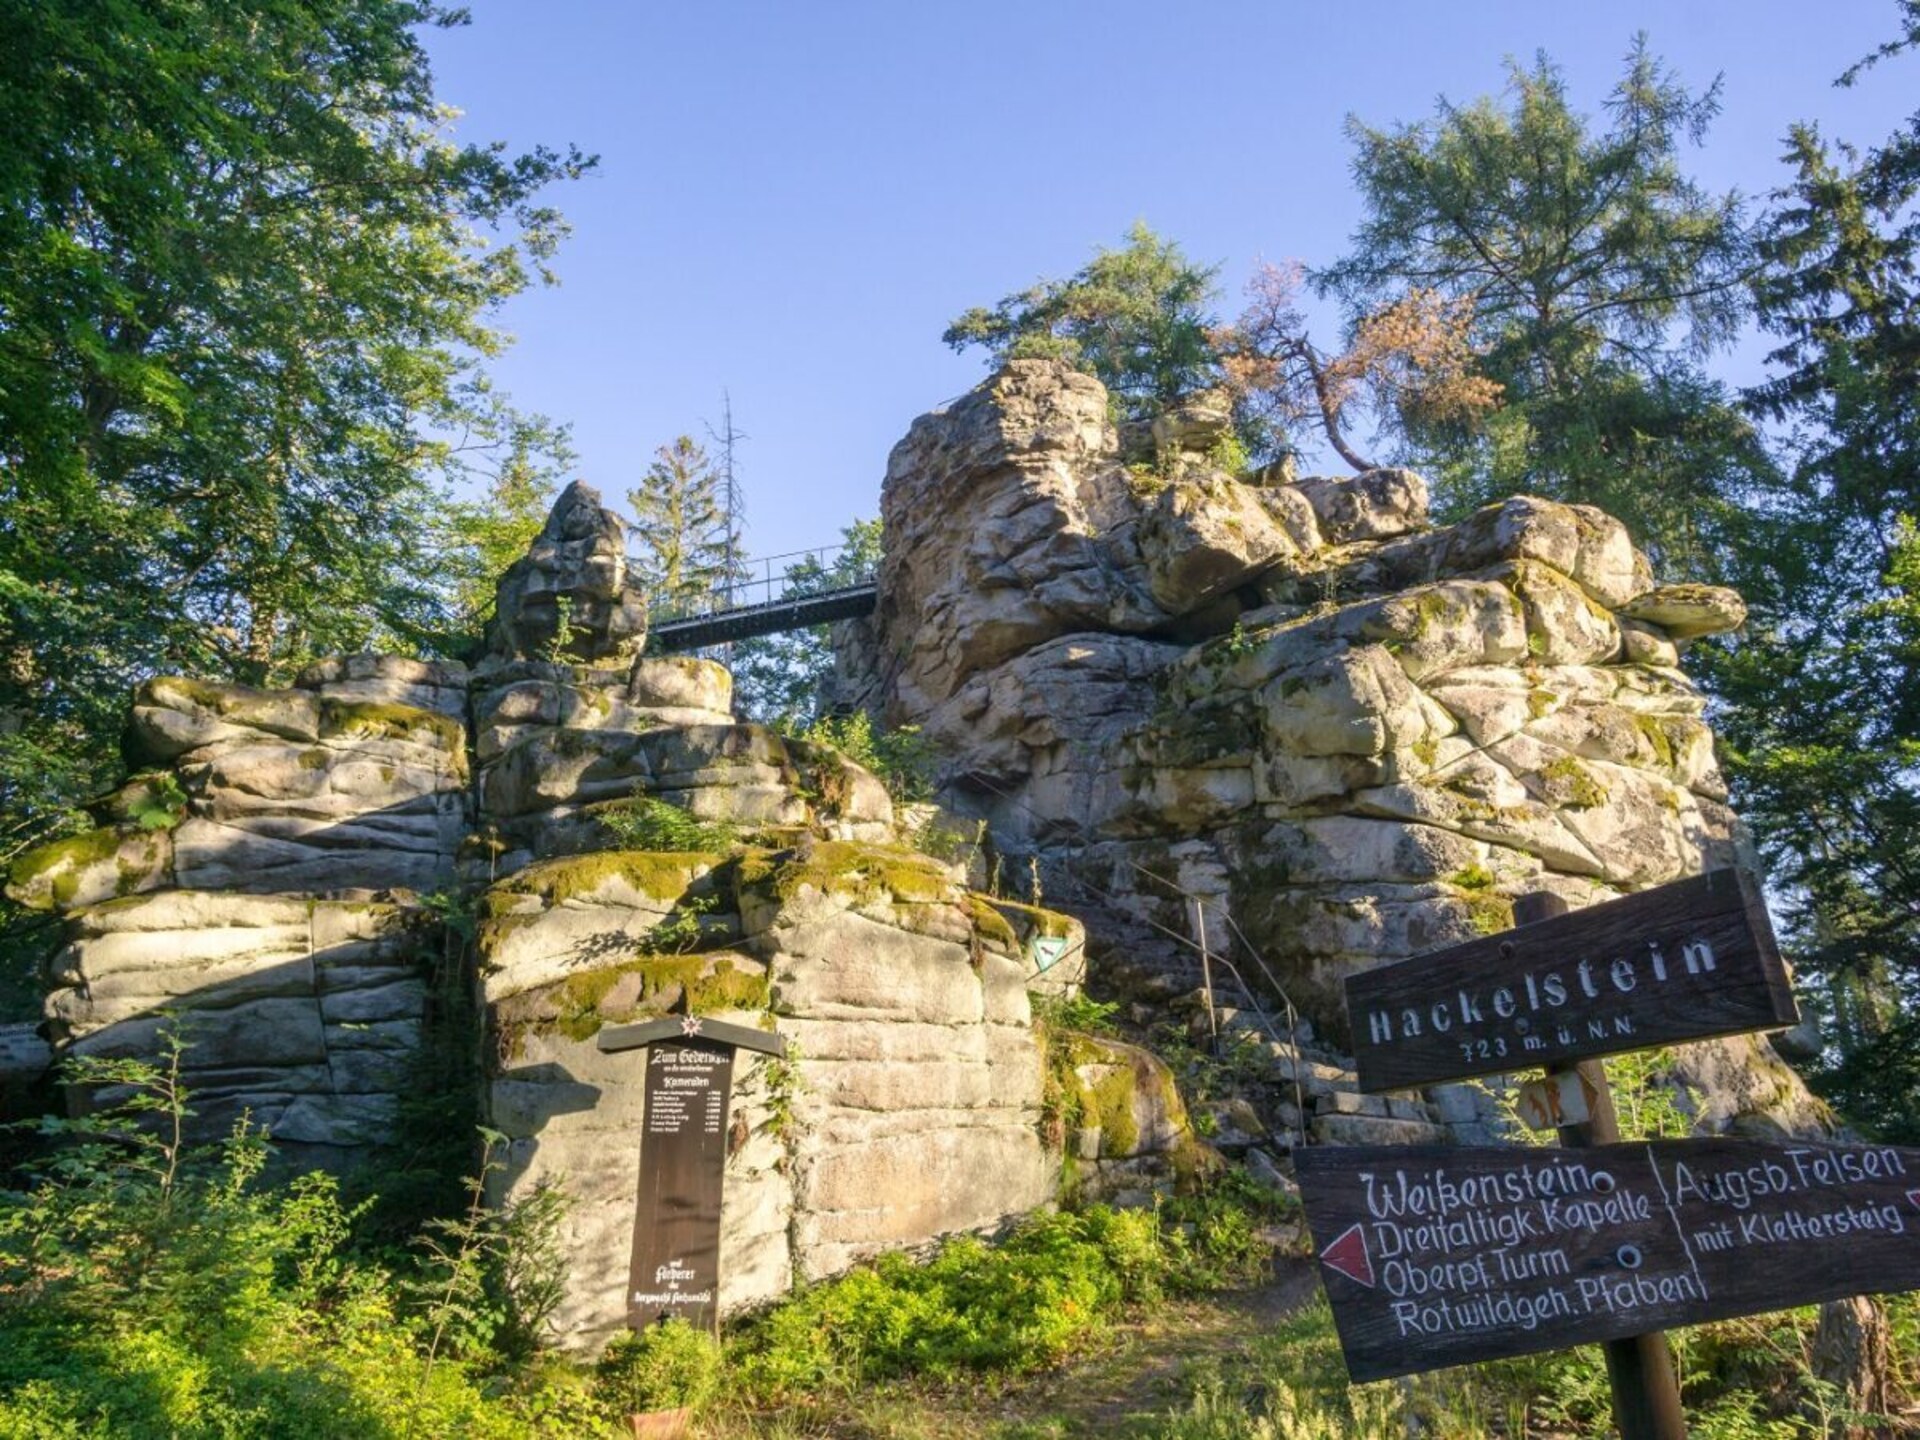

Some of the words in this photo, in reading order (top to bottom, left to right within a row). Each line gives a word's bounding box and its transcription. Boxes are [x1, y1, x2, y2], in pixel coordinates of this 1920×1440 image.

[1369, 937, 1716, 1044] Hackelstein
[651, 1048, 677, 1065] Zum
[1460, 1038, 1508, 1063] 723
[1523, 1034, 1547, 1051] m.
[1359, 1156, 1591, 1219] Weißenstein
[1784, 1148, 1906, 1189] Felsen
[1540, 1189, 1652, 1234] Kapelle
[1694, 1222, 1735, 1253] mit
[1738, 1200, 1904, 1244] Klettersteig
[1574, 1273, 1698, 1313] Pfaben
